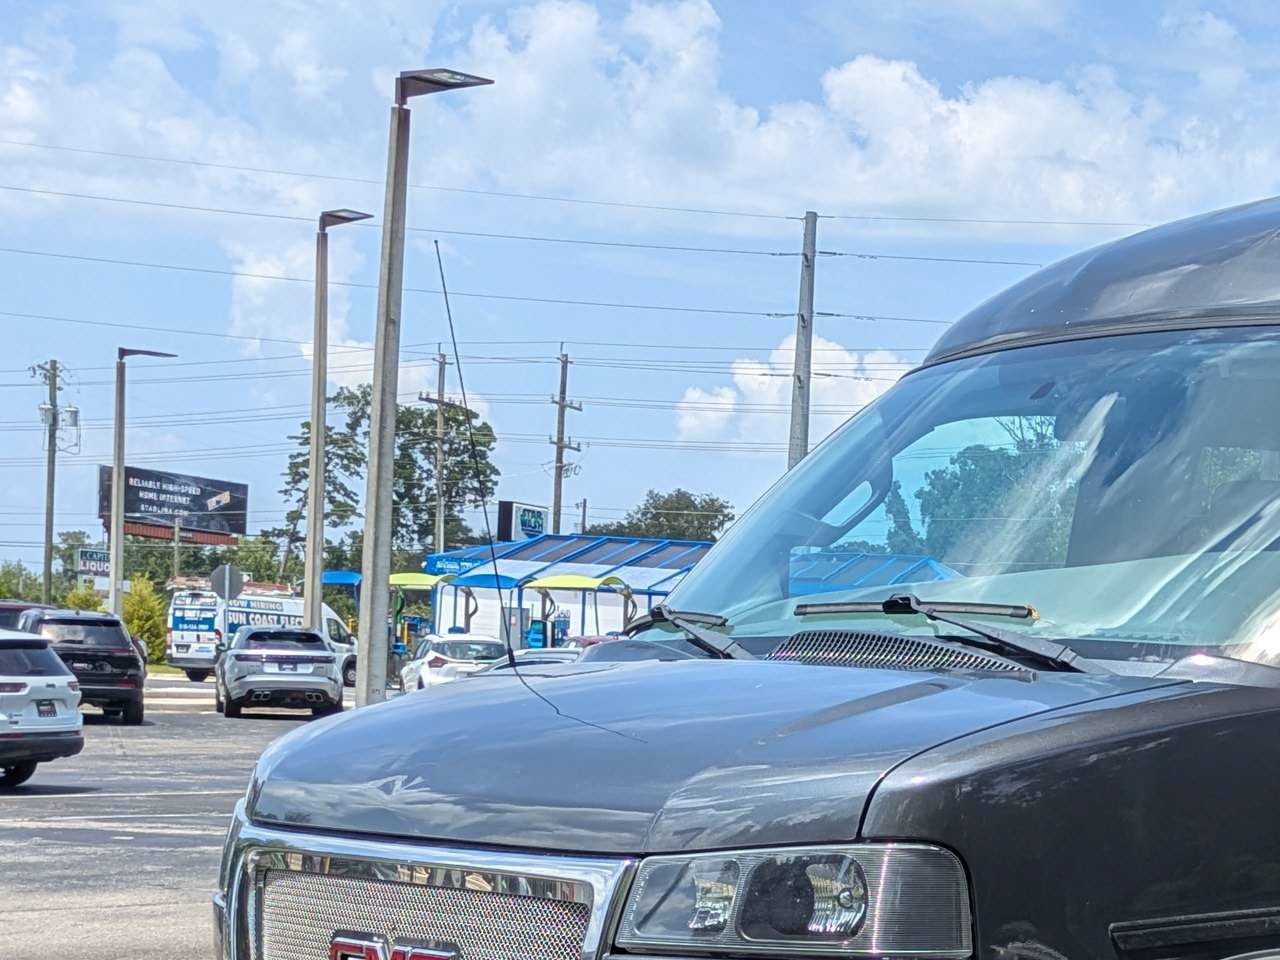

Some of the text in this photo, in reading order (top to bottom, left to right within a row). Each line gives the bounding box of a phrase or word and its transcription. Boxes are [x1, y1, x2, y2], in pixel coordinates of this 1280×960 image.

[129, 478, 200, 495] RELIABLE HIGH-SPEED
[139, 491, 190, 504] HOME INTERNET
[520, 509, 543, 519] STAR
[520, 517, 544, 530] WASH
[250, 601, 282, 610] HIRING
[229, 612, 247, 625] SUN
[249, 613, 278, 626] COAST
